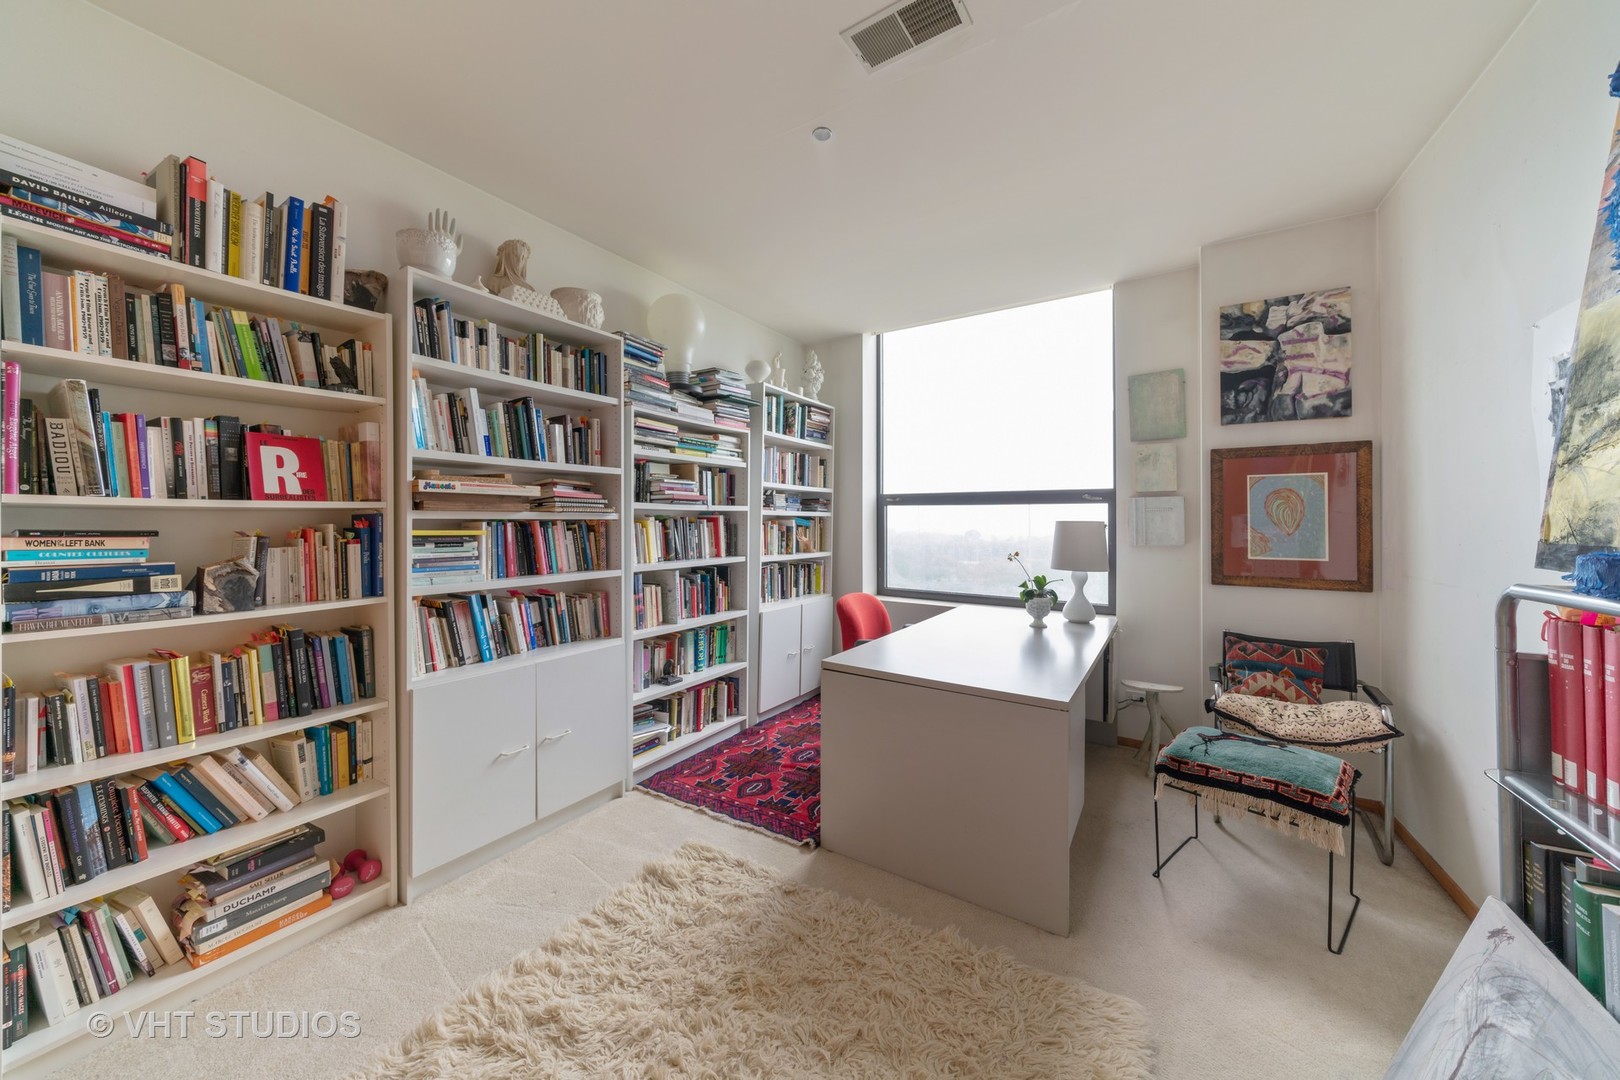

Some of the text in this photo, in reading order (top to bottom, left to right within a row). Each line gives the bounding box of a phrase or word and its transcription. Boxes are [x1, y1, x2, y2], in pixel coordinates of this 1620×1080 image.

[12, 176, 49, 193] DAVID
[53, 190, 91, 206] BAILEY
[100, 205, 133, 220] Ailleurs
[12, 200, 66, 221] MALEVICH
[47, 221, 73, 234] MODERN
[75, 229, 86, 237] ART
[87, 232, 99, 240] AND
[317, 217, 327, 297] La Subversion des images
[56, 290, 65, 341] ANTONIN ARTAUD
[7, 441, 18, 459] Atget
[50, 423, 71, 474] BADIOU
[260, 446, 303, 494] R
[19, 621, 46, 632] ERWIN
[138, 670, 149, 698] ARTIFICIAL
[142, 699, 151, 715] HELLS
[202, 709, 210, 724] Work
[106, 780, 119, 813] Complete
[112, 814, 123, 836] Poems
[264, 871, 285, 883] SELLER
[223, 885, 276, 913] DUCHAMP
[246, 896, 288, 917] Marcel Duchamp
